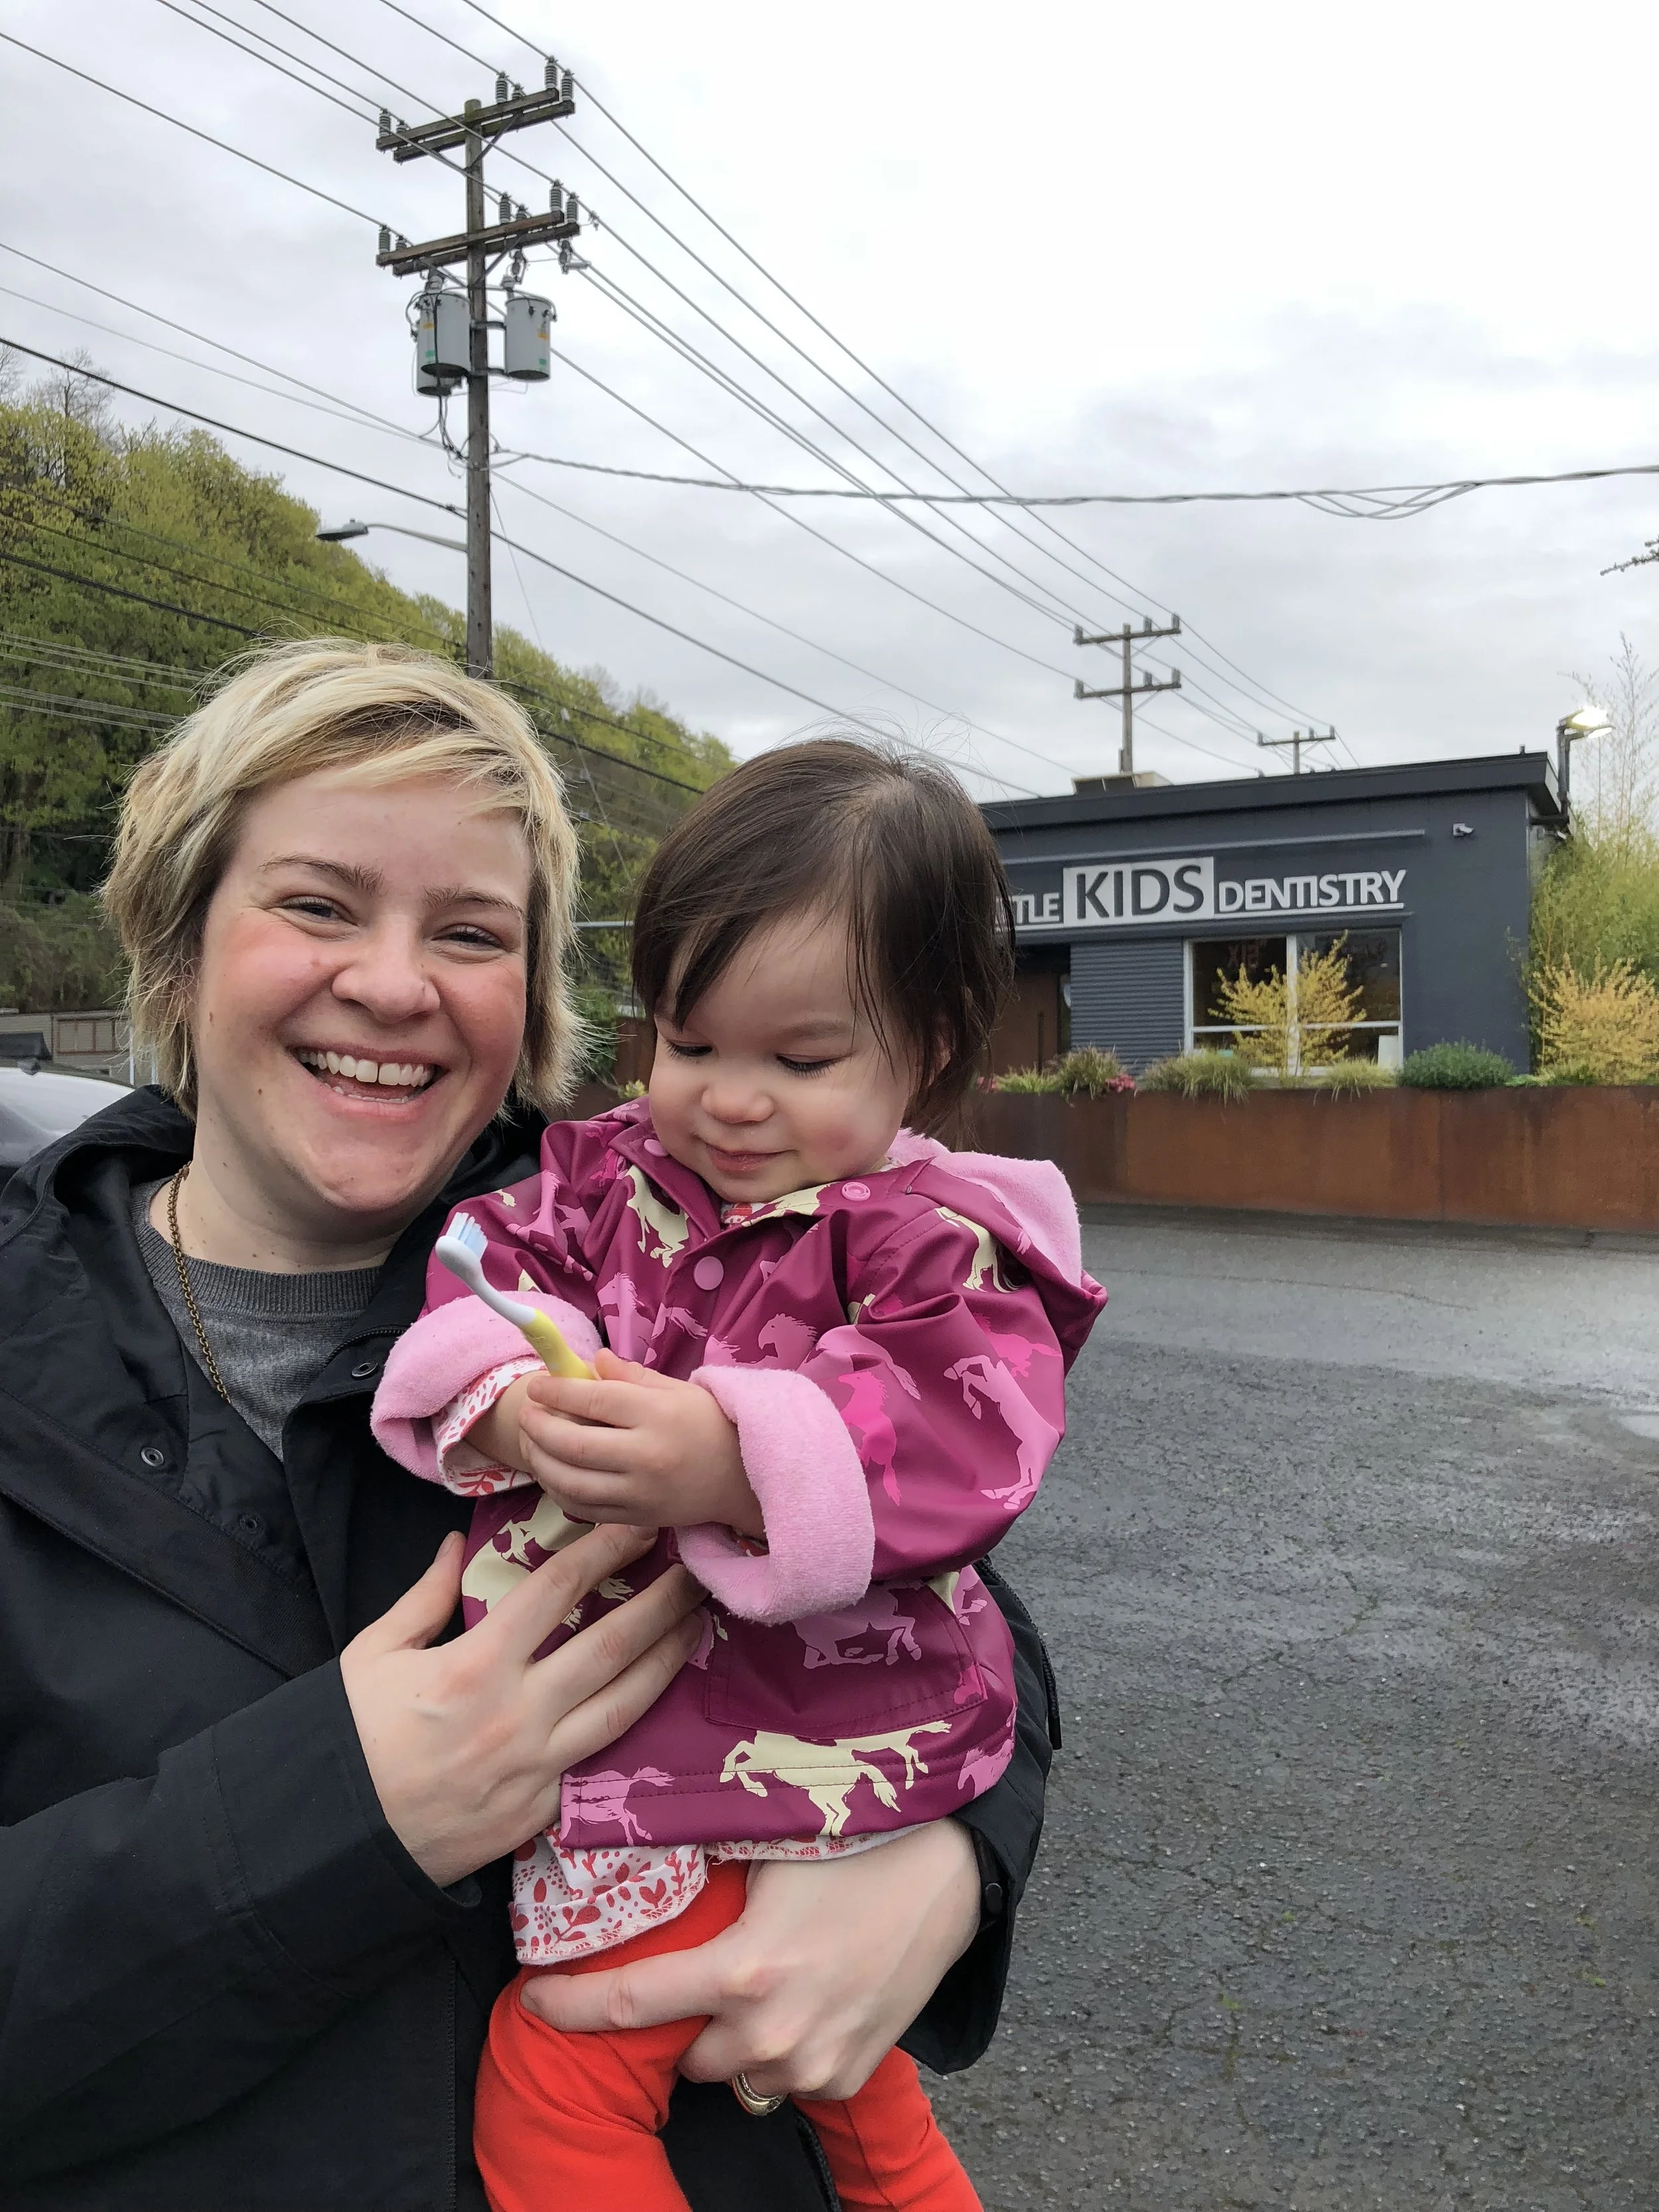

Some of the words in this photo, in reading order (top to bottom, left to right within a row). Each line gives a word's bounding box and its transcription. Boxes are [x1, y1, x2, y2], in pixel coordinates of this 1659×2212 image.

[995, 893, 1060, 924] TLE
[1076, 865, 1204, 919] KIDS
[1218, 869, 1407, 913] DENTISTRY
